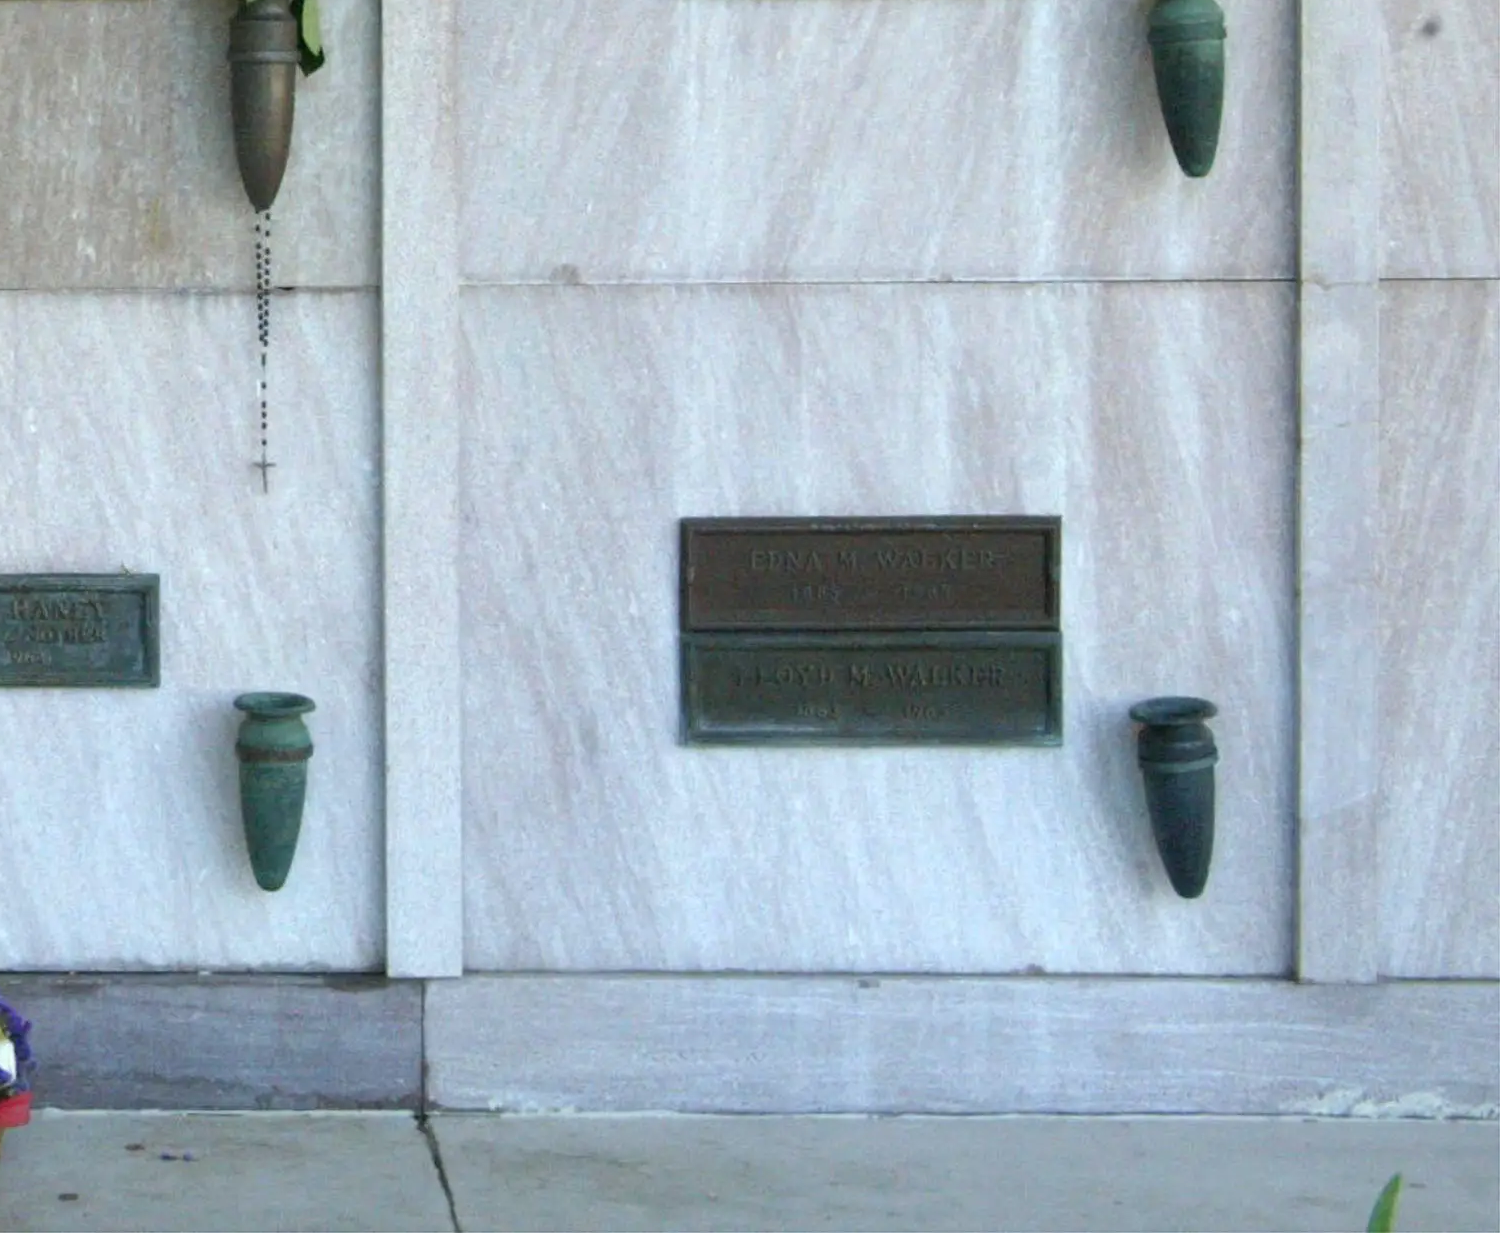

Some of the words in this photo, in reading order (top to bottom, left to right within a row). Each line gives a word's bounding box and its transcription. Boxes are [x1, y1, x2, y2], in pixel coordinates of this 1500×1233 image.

[751, 549, 824, 573] EDNA
[878, 547, 998, 570] WALKER
[886, 663, 1004, 688] WALKER
